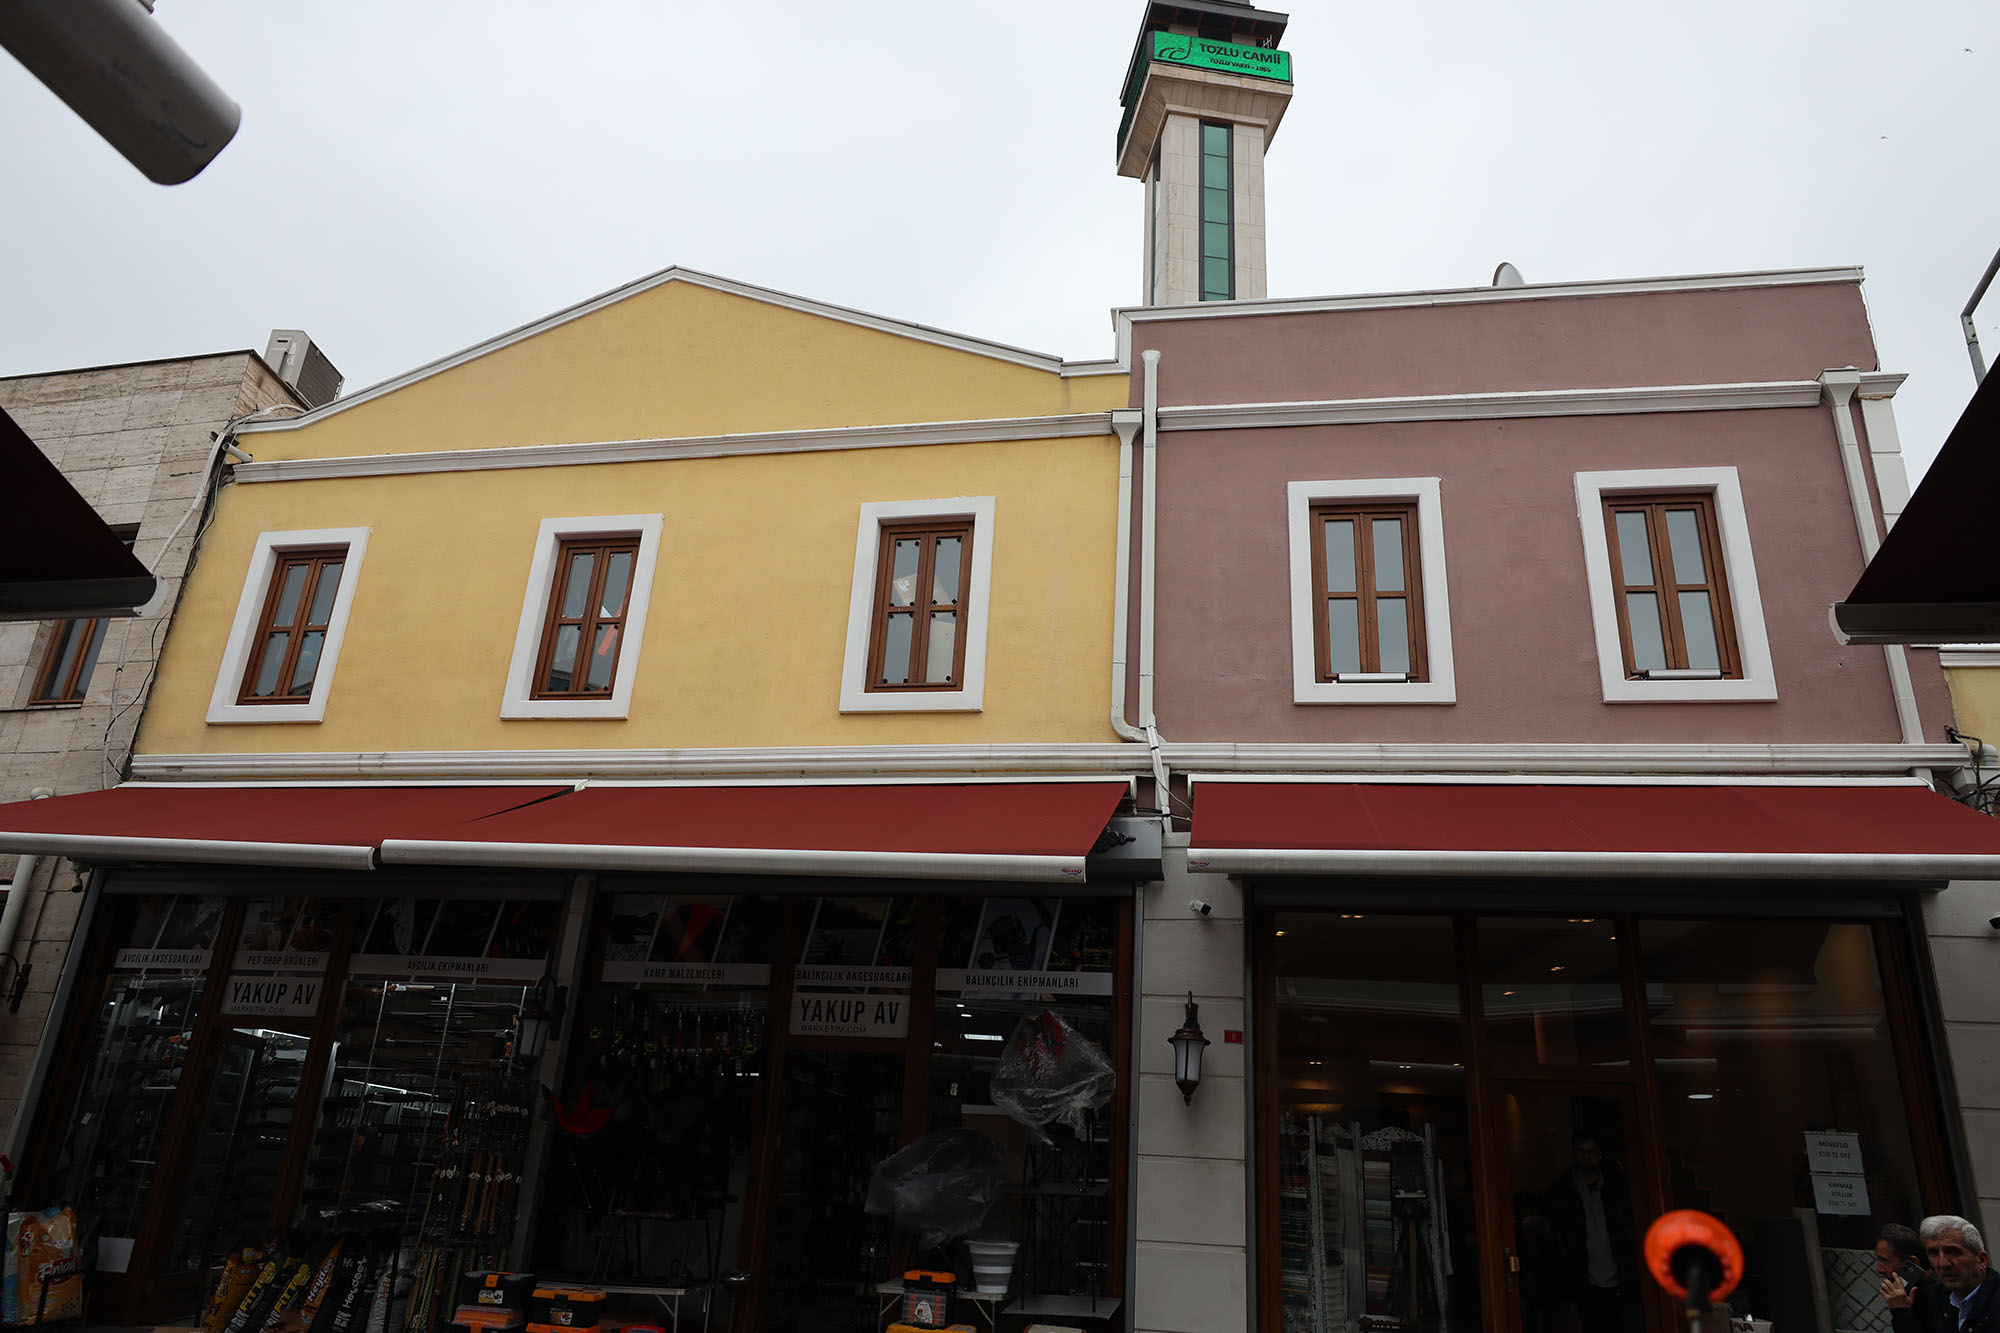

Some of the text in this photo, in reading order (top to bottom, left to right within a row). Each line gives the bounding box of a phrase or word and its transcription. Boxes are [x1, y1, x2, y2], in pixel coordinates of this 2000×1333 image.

[1199, 43, 1281, 65] TOZLU CAMİİ
[122, 953, 202, 964] AVCILIK AKSESUARLARI
[247, 955, 261, 965] PET
[262, 956, 282, 966] SHOP
[407, 959, 489, 973] AVCILIK EKİPMANLARI
[643, 967, 726, 981] KAMP MALZEMELERİ
[796, 969, 911, 982] BALIKÇILIK AKSESUARLARI
[965, 975, 1078, 988] BALIKÇILIK EKİPMANLARI
[232, 981, 316, 1005] YAKUP AV
[801, 999, 899, 1024] YAKUP AV
